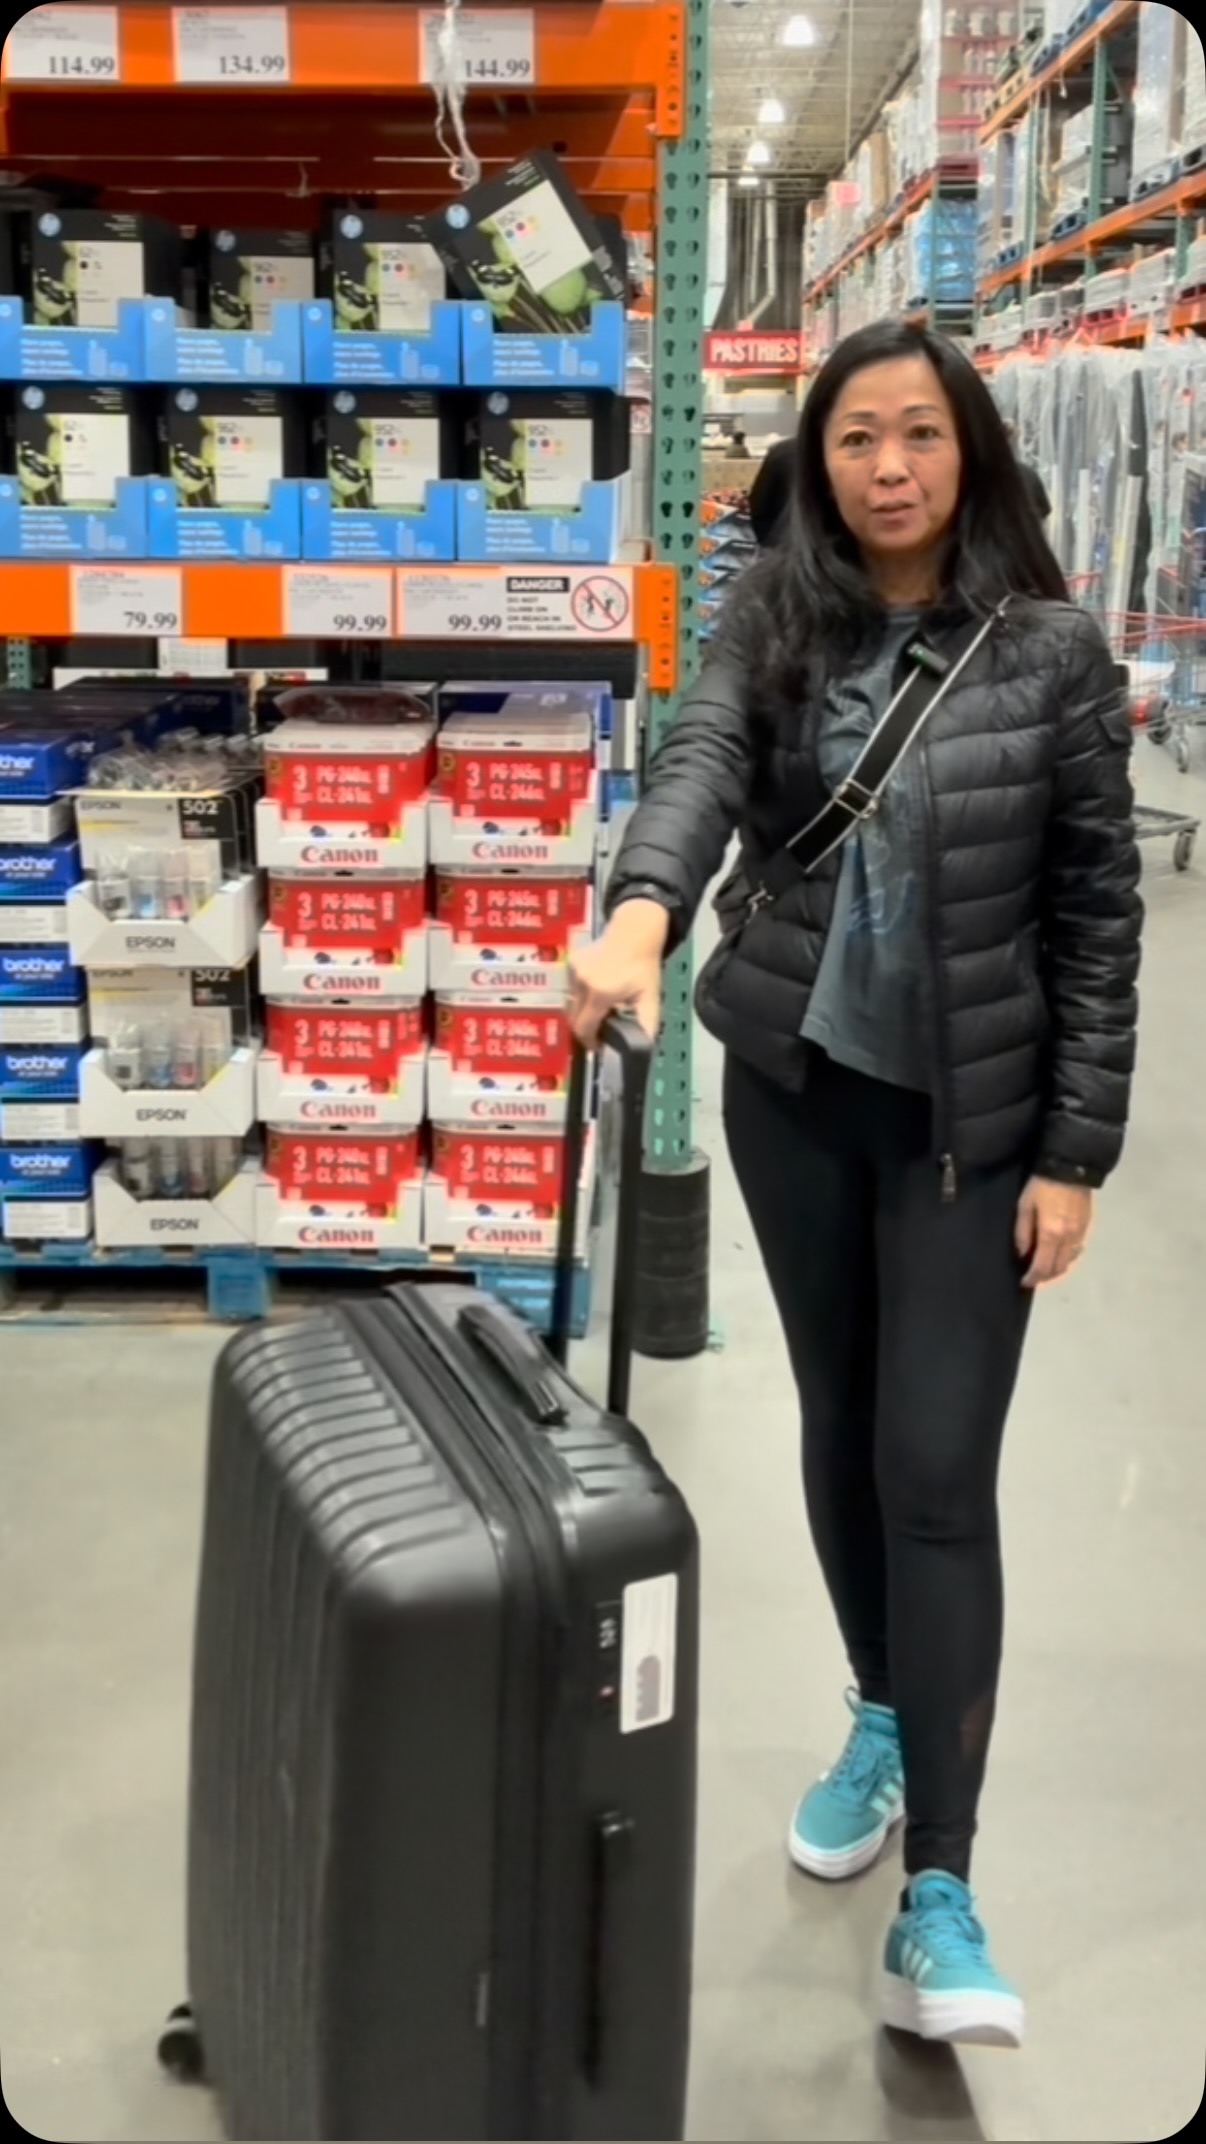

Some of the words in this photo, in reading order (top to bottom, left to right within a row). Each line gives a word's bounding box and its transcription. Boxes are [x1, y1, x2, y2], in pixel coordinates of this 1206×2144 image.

[49, 56, 115, 75] 114.99
[219, 55, 285, 74] 134.99
[465, 59, 530, 78] 144.99
[711, 337, 798, 362] PASTRIES
[511, 579, 563, 590] DANGER
[123, 611, 177, 629] 79.99
[333, 615, 387, 631] 99.99
[448, 615, 502, 632] 99.99
[0, 754, 34, 769] ther
[293, 765, 307, 791] 3
[466, 762, 480, 787] 3
[183, 801, 219, 814] 502
[300, 846, 378, 863] Canon
[472, 842, 548, 859] Canon
[298, 892, 312, 917] 3
[464, 889, 478, 914] 3
[126, 936, 175, 949] EPSON
[3, 958, 65, 972] brother
[303, 973, 380, 990] Canon
[471, 969, 547, 986] Canon
[295, 1019, 309, 1045] 3
[463, 1018, 477, 1043] 3
[6, 1057, 68, 1070] brother
[136, 1109, 186, 1121] EPSON
[300, 1101, 376, 1117] Canon
[471, 1100, 546, 1116] Canon
[10, 1154, 71, 1168] brother
[293, 1146, 307, 1171] 3
[460, 1145, 474, 1171] 3
[150, 1219, 199, 1231] EPSON
[298, 1227, 374, 1243] Canon
[467, 1226, 542, 1242] Canon
